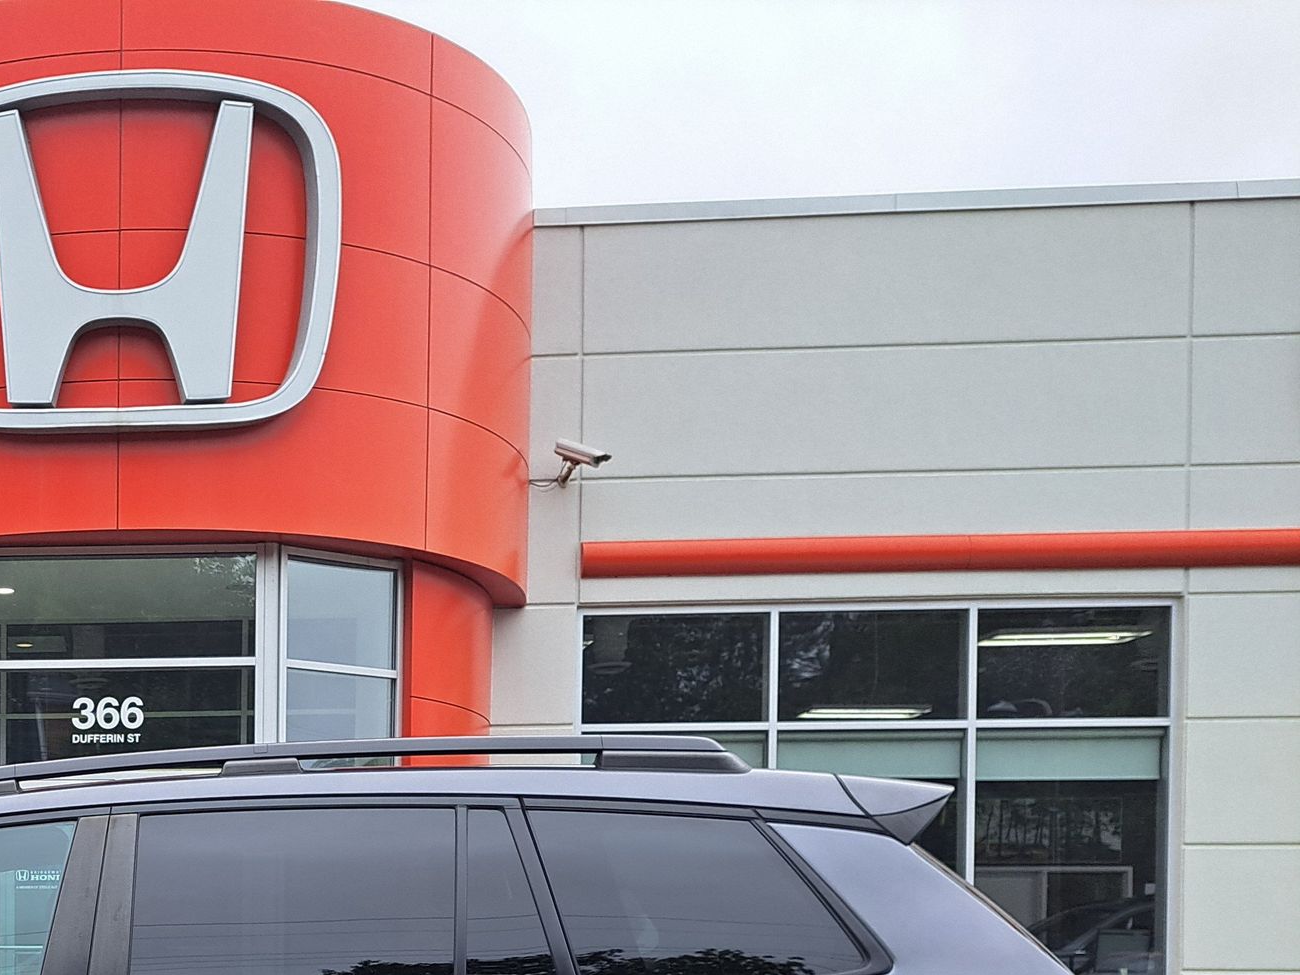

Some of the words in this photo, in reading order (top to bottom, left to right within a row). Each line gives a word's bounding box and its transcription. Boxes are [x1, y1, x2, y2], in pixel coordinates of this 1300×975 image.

[71, 696, 145, 730] 366
[71, 733, 125, 744] DUFFERIN
[126, 733, 142, 743] ST
